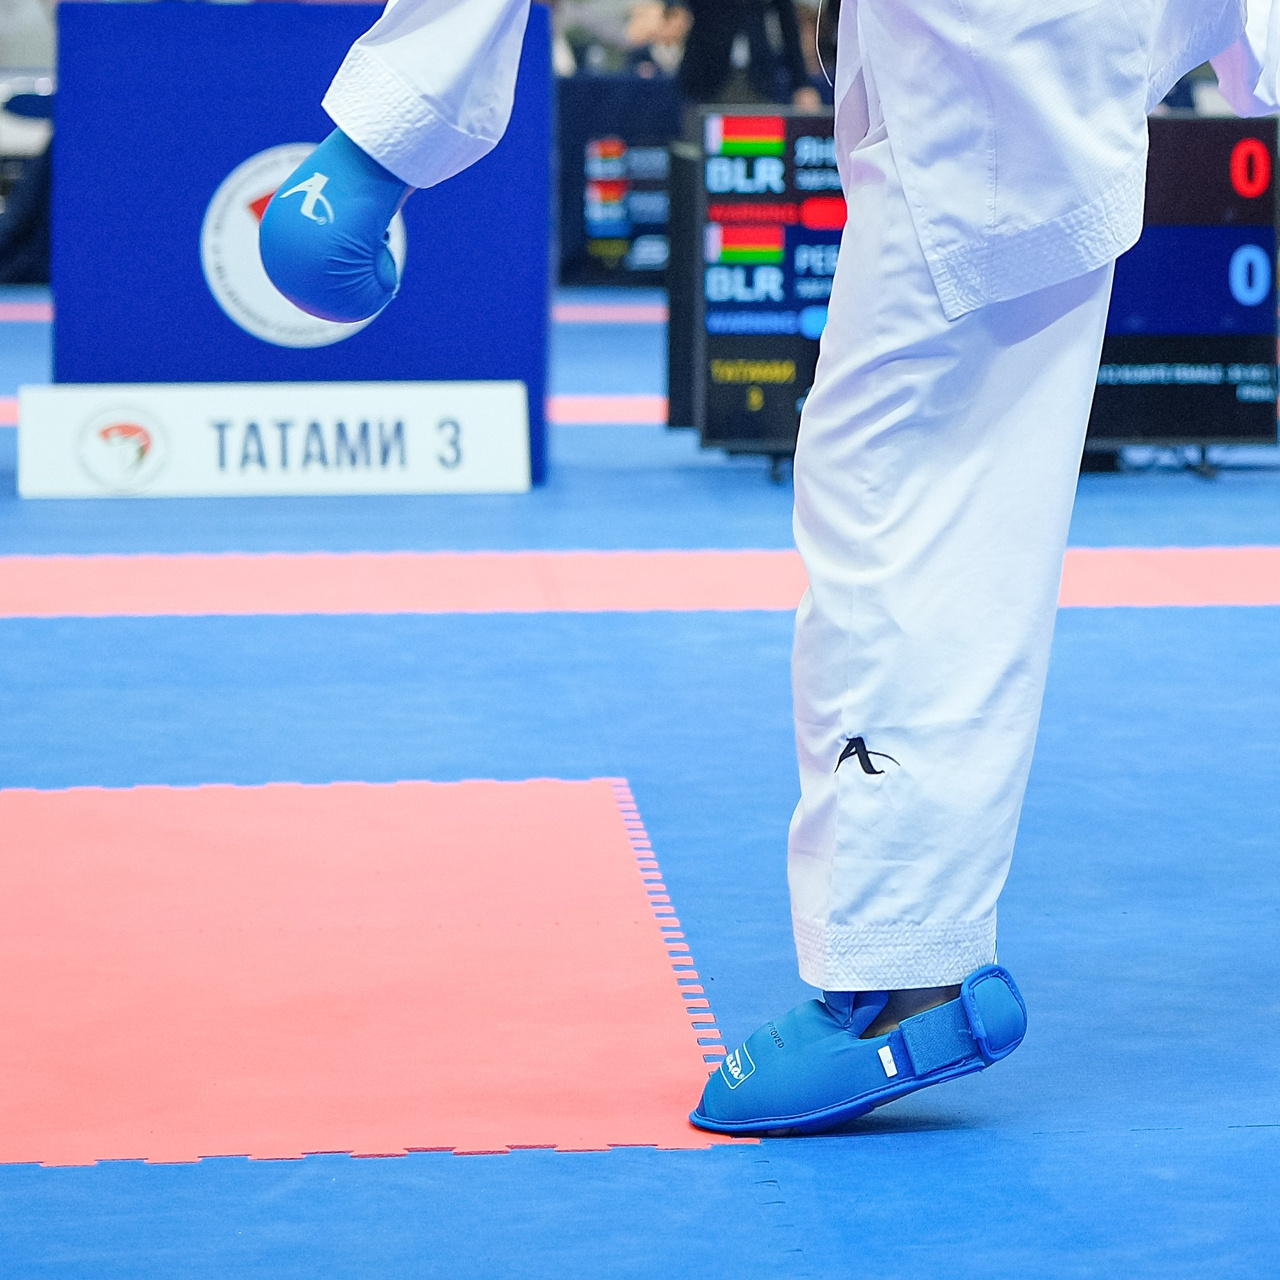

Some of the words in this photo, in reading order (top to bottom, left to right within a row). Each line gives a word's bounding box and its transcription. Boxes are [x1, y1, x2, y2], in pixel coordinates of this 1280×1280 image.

[705, 155, 785, 194] BLR
[1229, 137, 1272, 199] 0
[705, 265, 785, 303] BLR
[1228, 243, 1272, 307] 0
[211, 417, 407, 472] ТАТАМИ
[437, 417, 463, 471] 3
